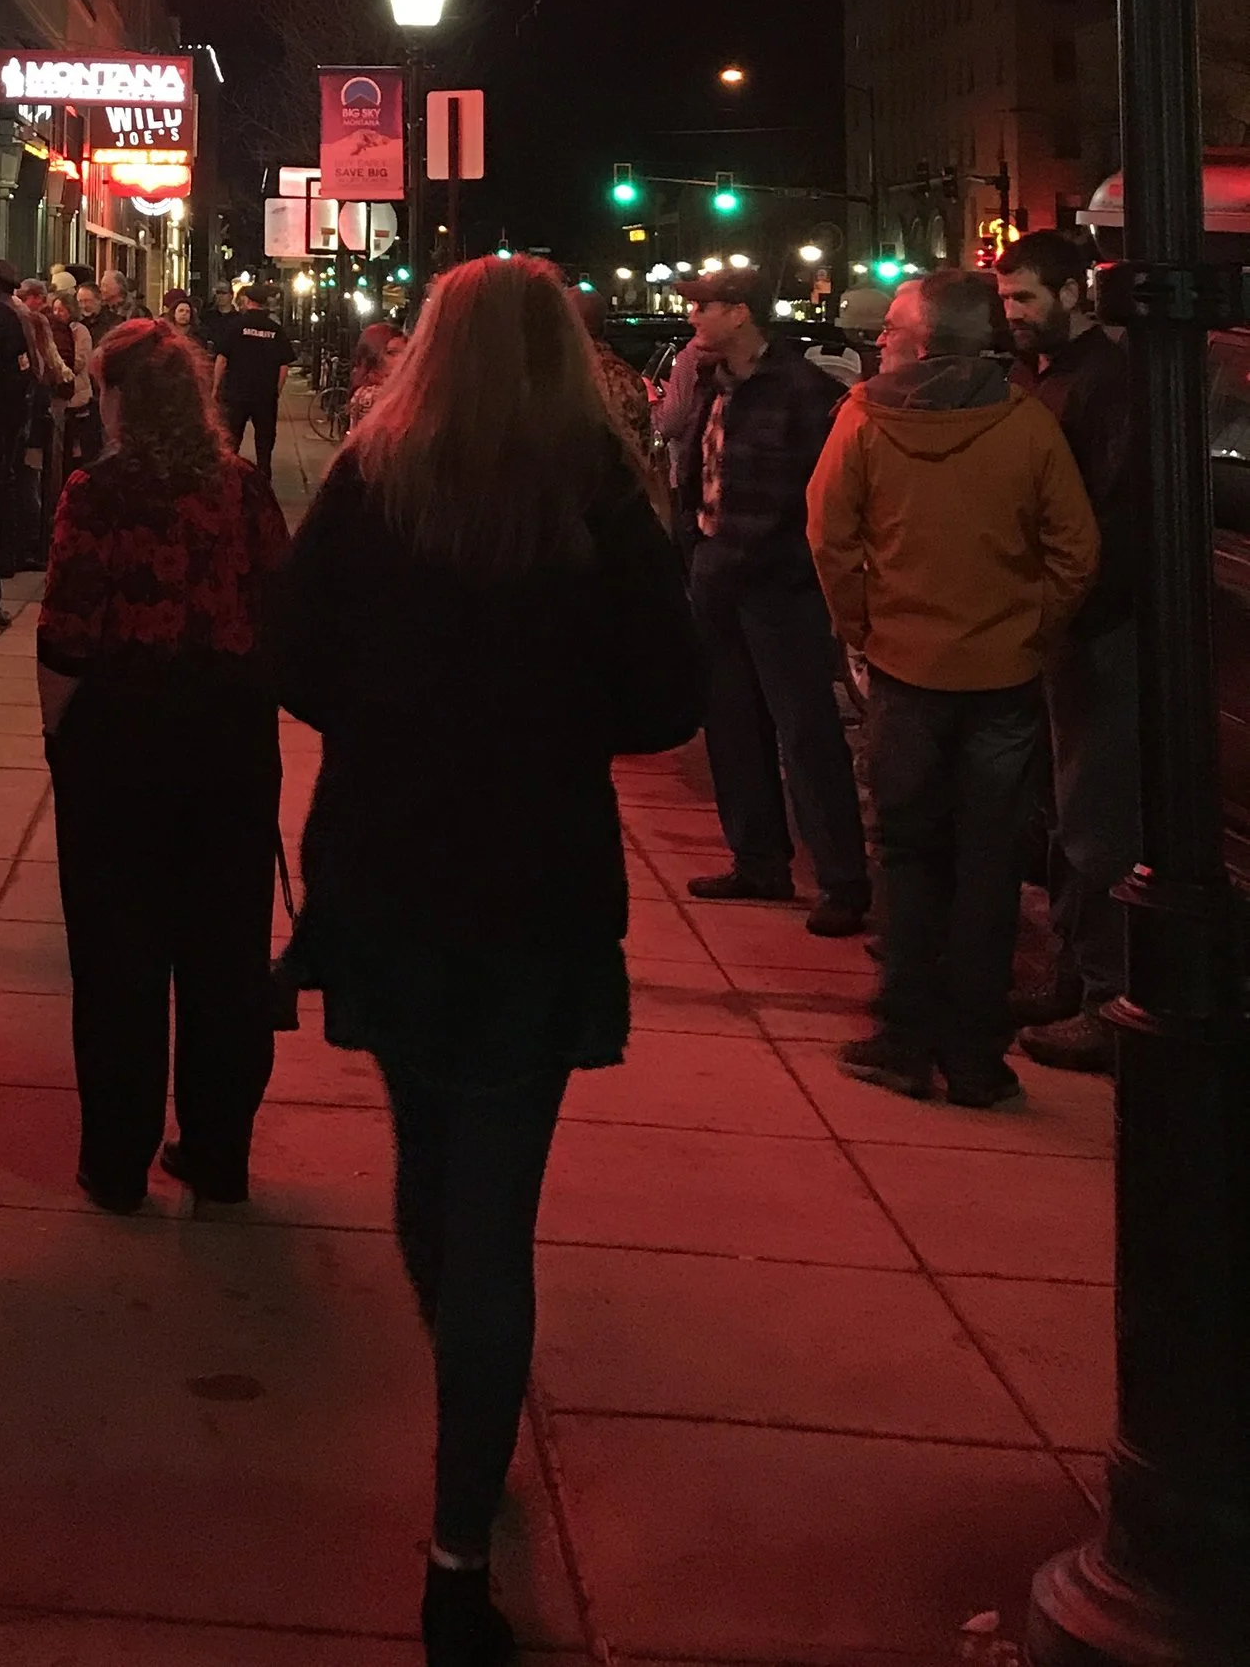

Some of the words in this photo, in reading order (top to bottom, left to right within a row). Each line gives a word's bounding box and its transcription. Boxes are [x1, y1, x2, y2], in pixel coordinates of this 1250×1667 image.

[26, 61, 186, 90] MONTANA
[106, 107, 183, 133] WILD
[342, 108, 360, 118] BIG
[361, 108, 381, 118] SKY
[115, 128, 181, 147] JOE'S
[335, 167, 364, 177] SAVE
[368, 168, 389, 178] BIG
